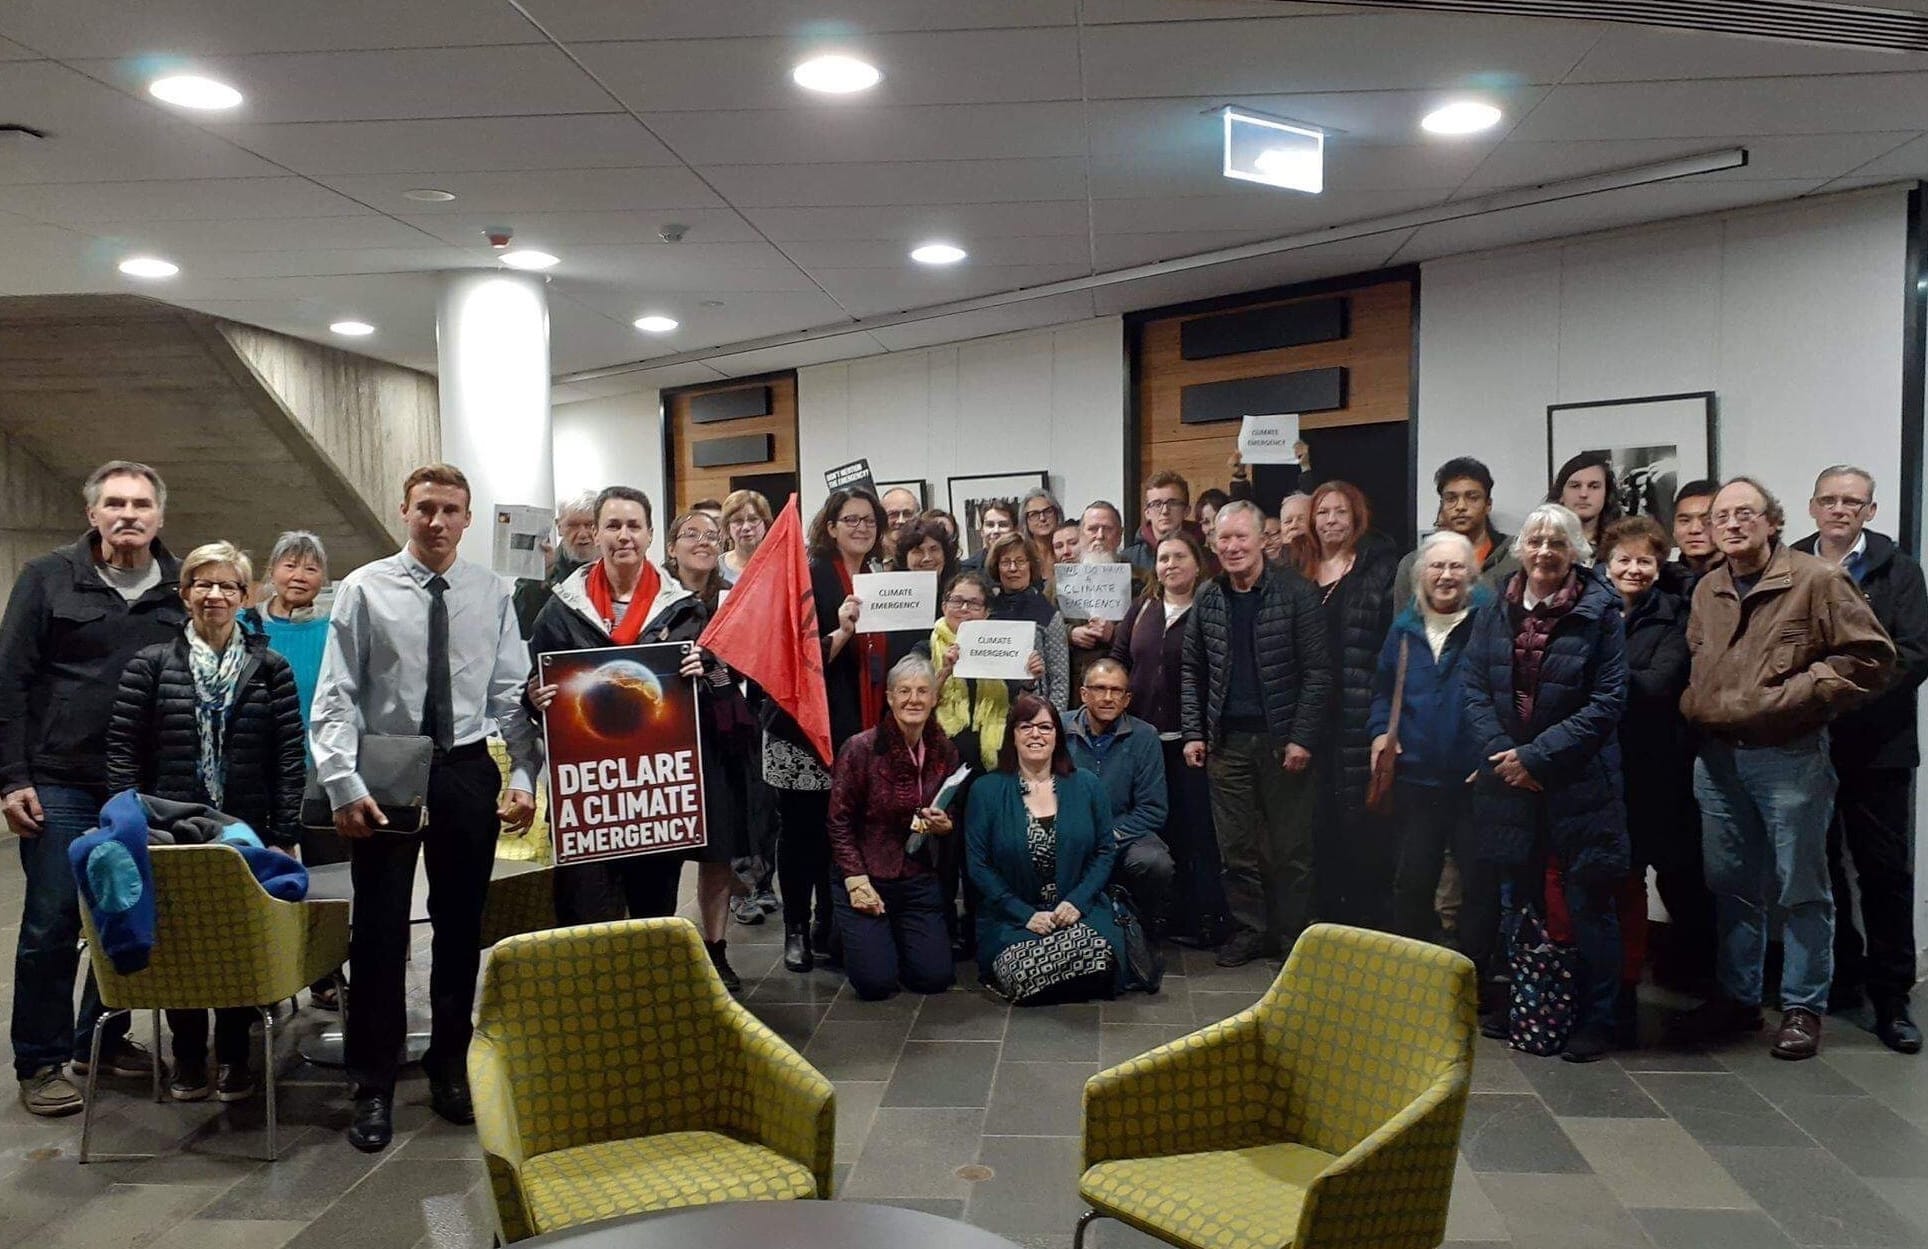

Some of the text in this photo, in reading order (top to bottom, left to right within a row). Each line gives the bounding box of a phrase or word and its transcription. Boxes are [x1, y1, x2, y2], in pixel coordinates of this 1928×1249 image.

[878, 588, 913, 597] CLIMATE
[1063, 583, 1116, 594] CLIMATE
[870, 601, 920, 610] EMERGENCY
[1064, 598, 1121, 610] EMERGENCY
[977, 636, 1012, 645] CLIMATE
[969, 648, 1019, 658] EMERGENCY
[557, 750, 694, 796] DECLARE
[559, 784, 699, 829] A CLIMATE
